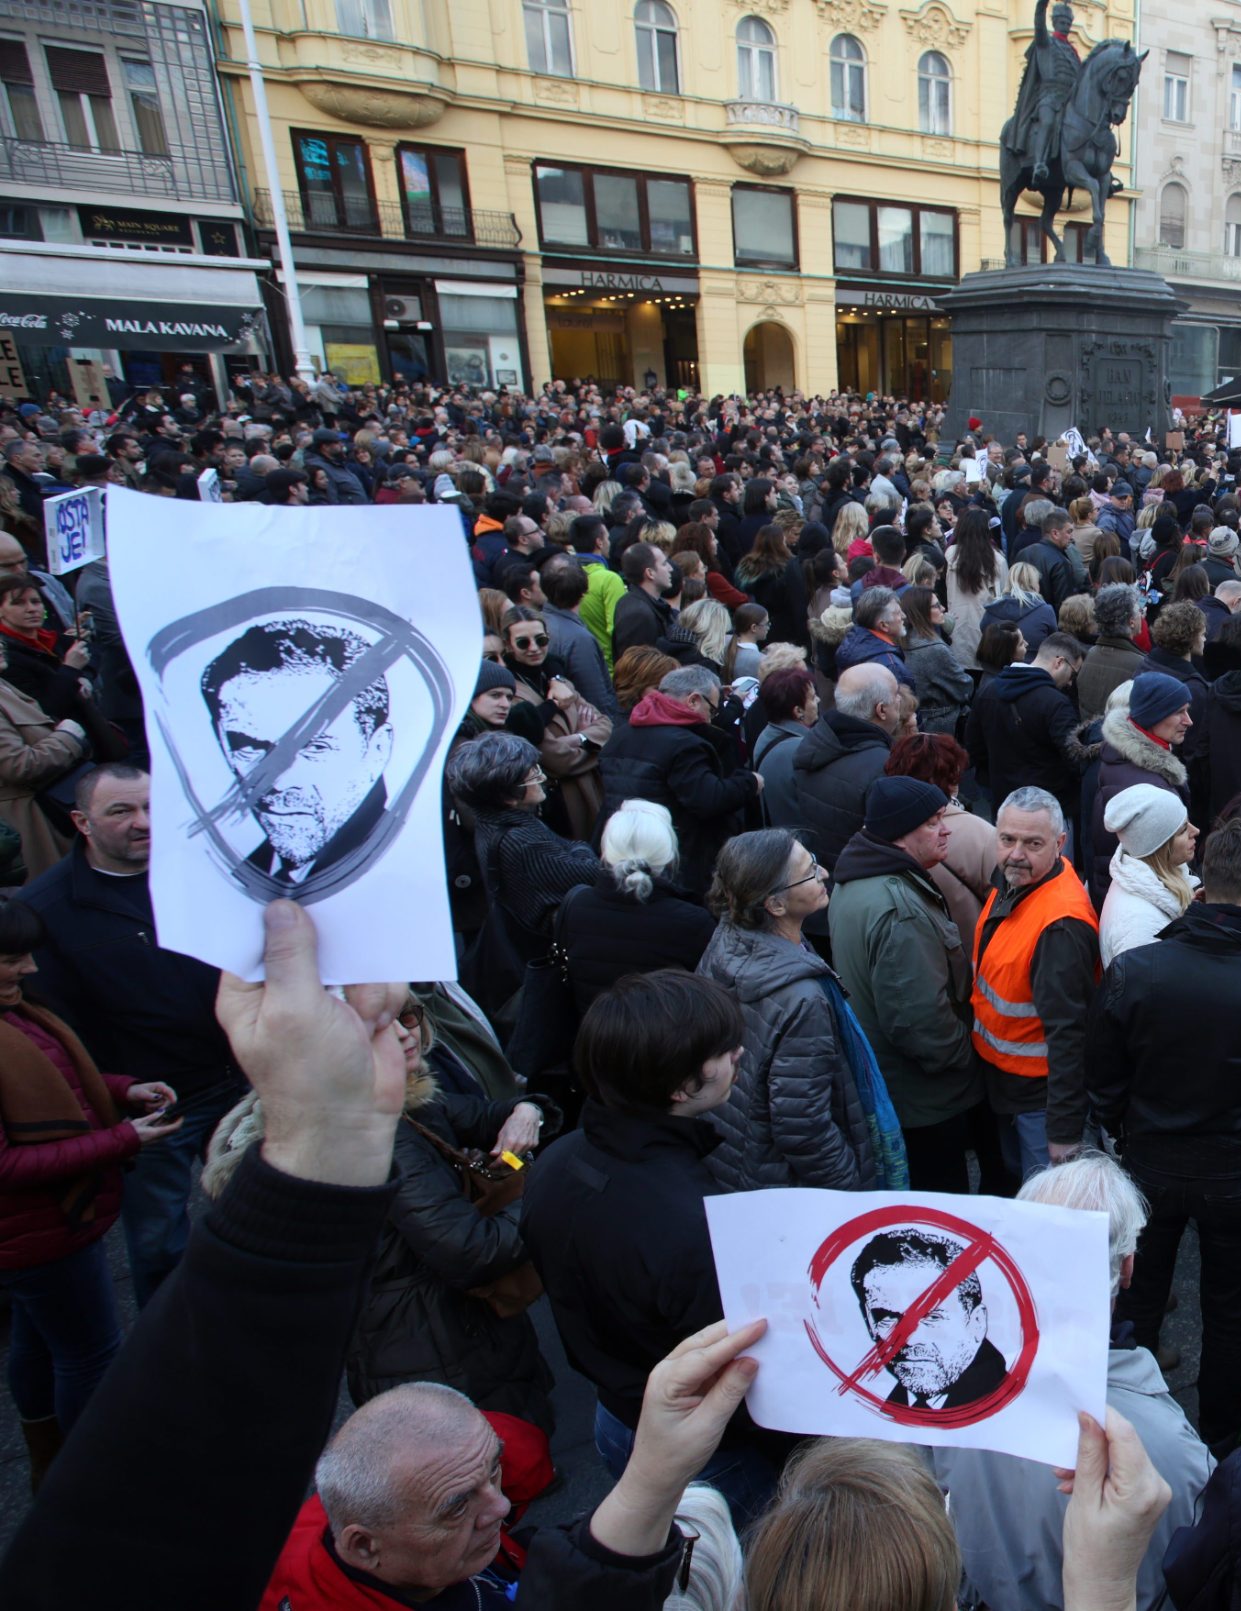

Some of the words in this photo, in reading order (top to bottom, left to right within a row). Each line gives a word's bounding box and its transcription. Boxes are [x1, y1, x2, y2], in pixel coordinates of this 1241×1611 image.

[580, 271, 663, 291] HARMICA
[864, 292, 930, 310] HARMICA
[105, 318, 158, 334] MALA
[158, 321, 229, 338] KAVANA
